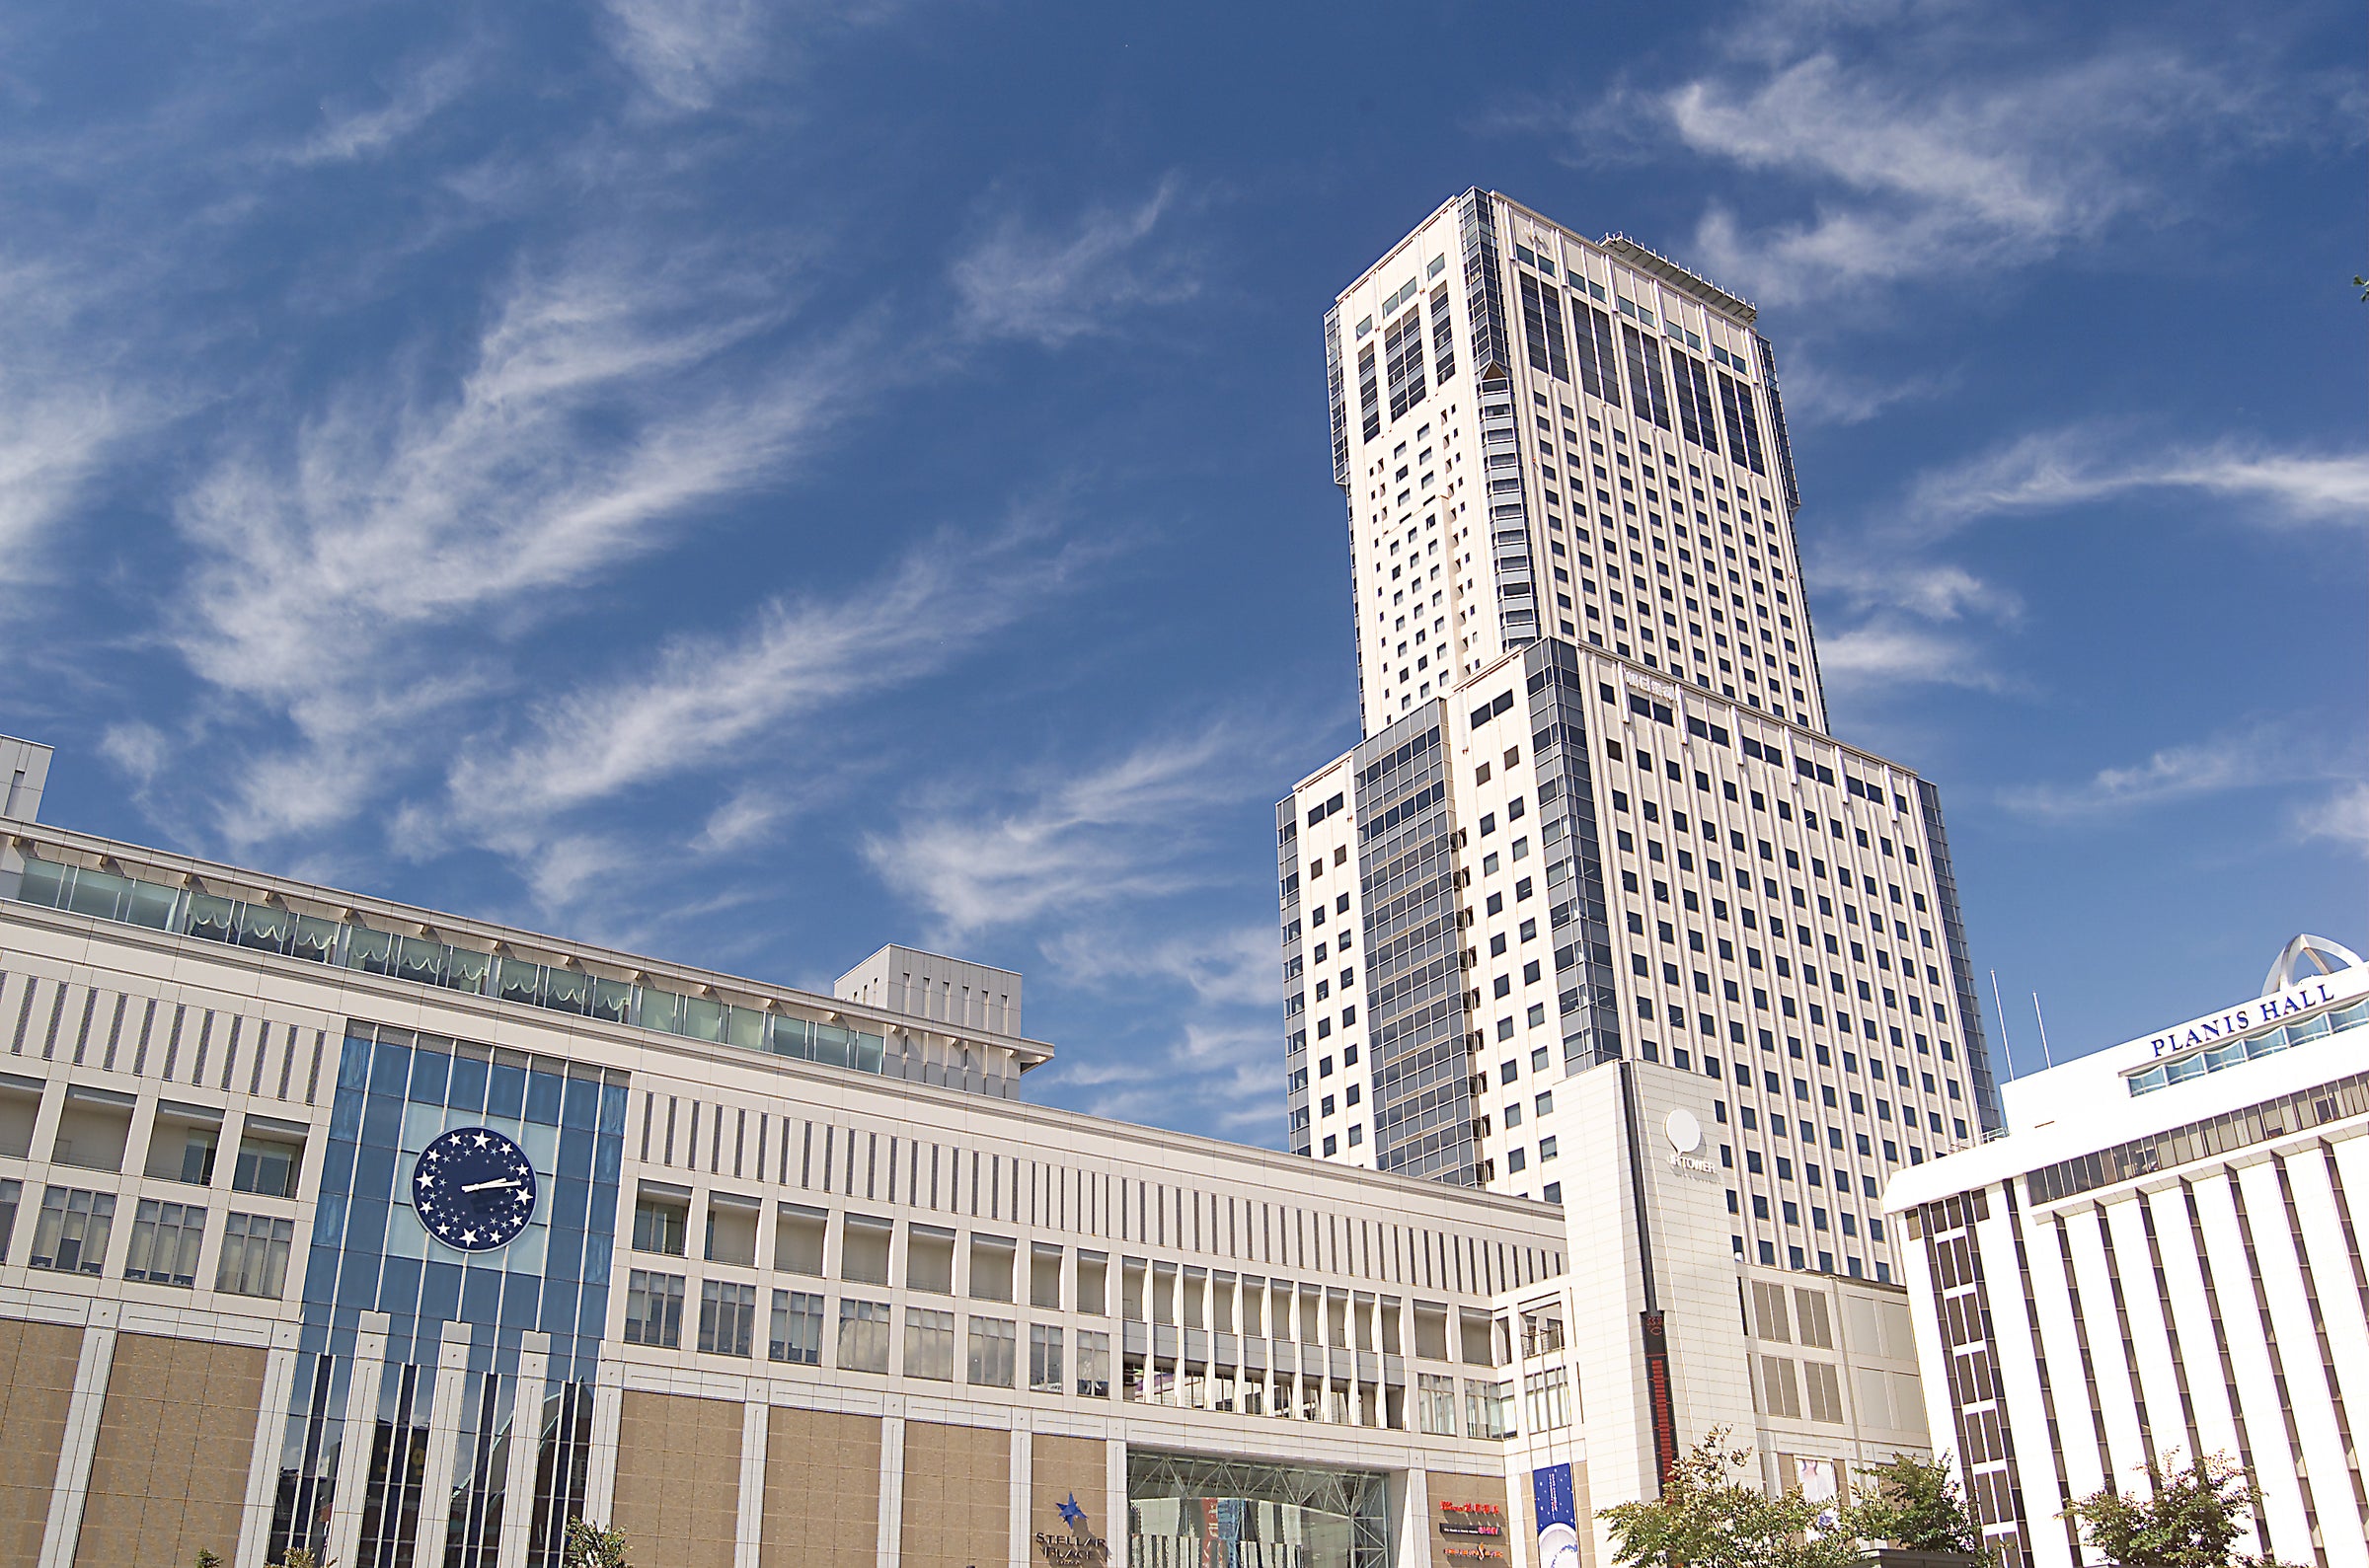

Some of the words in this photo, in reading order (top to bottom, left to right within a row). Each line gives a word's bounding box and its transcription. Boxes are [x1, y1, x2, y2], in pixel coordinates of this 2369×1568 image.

[2150, 1009, 2250, 1058] PLANIS
[2260, 984, 2334, 1022] HALL
[1680, 1156, 1717, 1174] TOWER
[1035, 1531, 1107, 1547] STELLAR
